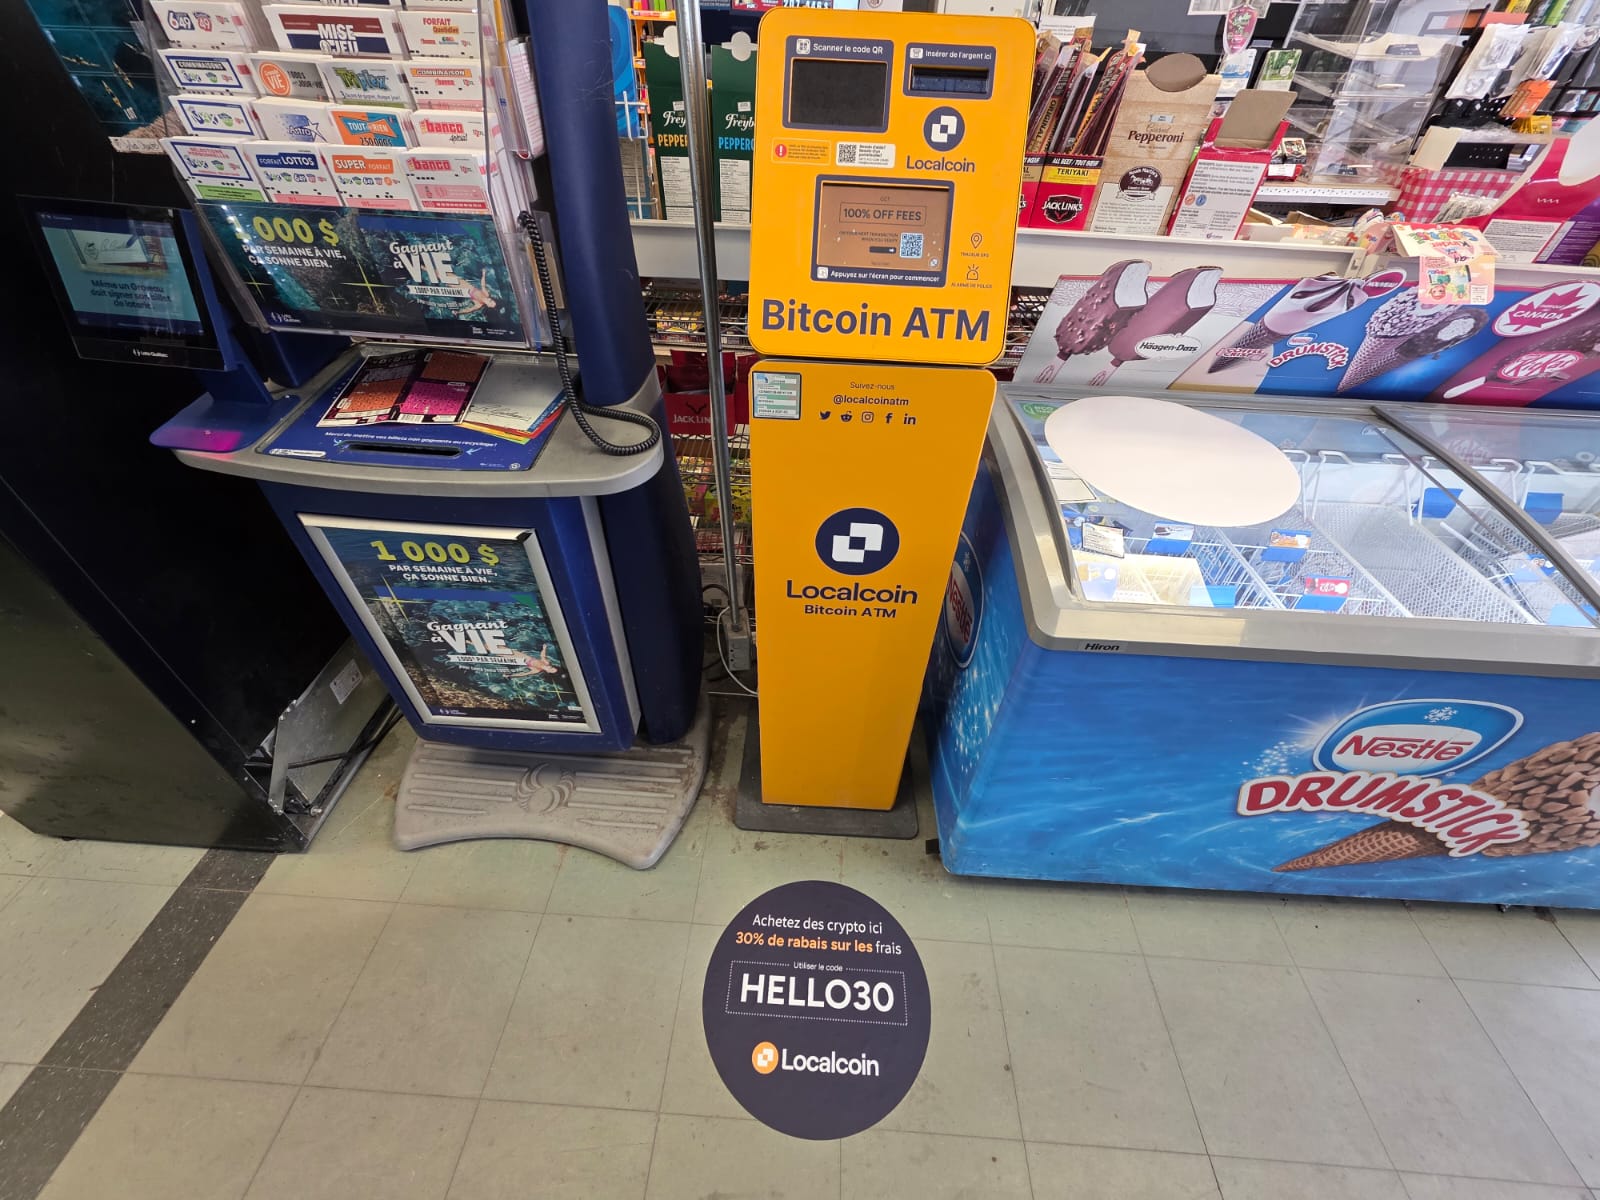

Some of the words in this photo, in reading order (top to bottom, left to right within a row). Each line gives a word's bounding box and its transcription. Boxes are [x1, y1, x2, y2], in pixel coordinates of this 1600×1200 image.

[318, 24, 356, 40] MISE
[813, 43, 843, 53] Scanner
[845, 45, 851, 53] le
[852, 45, 870, 54] code
[872, 46, 883, 55] QR
[925, 49, 948, 58] Insérer
[949, 51, 957, 59] de
[959, 51, 982, 60] l'argent
[1037, 99, 1057, 138] ORIGINAL
[348, 122, 366, 131] TOUT
[425, 119, 464, 134] banco
[1128, 130, 1184, 144] Pepperoni
[281, 156, 314, 166] LOTTOS
[336, 159, 366, 169] SUPER
[413, 158, 451, 171] banco
[906, 155, 976, 173] Localcoin
[1057, 168, 1089, 176] TERIYAKI
[1042, 201, 1061, 210] JACK
[843, 208, 870, 219] 100%
[873, 209, 894, 220] OFF
[896, 210, 921, 221] FEES
[253, 216, 314, 244] 000
[319, 219, 340, 247] $
[243, 245, 264, 255] PAR
[265, 245, 311, 257] SEMAINE
[313, 244, 323, 257] À
[326, 249, 347, 260] VIE,
[389, 240, 454, 255] Gagnant
[264, 257, 302, 266] SONNE
[303, 258, 333, 268] BIEN.
[393, 256, 403, 269] à
[397, 252, 460, 285] VIE
[831, 270, 857, 280] Appuyez
[869, 271, 888, 280] l'écran
[890, 273, 903, 281] pour
[762, 297, 892, 336] Bitcoin
[902, 306, 990, 341] ATM
[1512, 310, 1564, 320] CANADA
[1139, 341, 1199, 353] Häagen-Dazs
[1269, 342, 1348, 369] DRUMSTICK
[850, 381, 895, 390] Suivez-nous
[833, 394, 909, 406] @localcoinatm
[672, 413, 694, 424] JACK
[370, 540, 396, 561] 1
[401, 541, 471, 564] 000
[478, 543, 499, 566] $
[389, 564, 411, 574] PAR
[412, 565, 462, 575] SEMAINE
[463, 564, 474, 575] À
[475, 567, 498, 577] VIE,
[403, 573, 419, 582] ÇA
[421, 573, 459, 582] SONNE
[461, 575, 491, 583] BIEN.
[787, 579, 918, 604] Localcoin
[804, 604, 857, 616] Bitcoin
[861, 607, 897, 618] ATM
[427, 619, 508, 632] Gagnant
[431, 634, 444, 643] à
[439, 629, 513, 655] VIE
[1084, 642, 1120, 652] Hiron
[476, 656, 488, 664] PAR
[489, 657, 517, 665] SEMAINE
[1337, 735, 1476, 761] Nestlé
[1245, 775, 1523, 854] DRUMSTICK
[752, 914, 801, 929] Achetez
[803, 917, 824, 931] des
[827, 920, 866, 935] crypto
[869, 921, 883, 934] ici
[735, 931, 765, 946] 30%
[768, 934, 784, 947] de
[787, 935, 828, 950] rabais
[830, 940, 851, 952] sur
[854, 940, 873, 953] les
[876, 941, 902, 955] frais
[793, 961, 817, 971] Utiliser
[818, 963, 824, 971] le
[825, 963, 843, 972] code
[740, 973, 894, 1013] HELLO30
[781, 1048, 880, 1077] Localcoin
